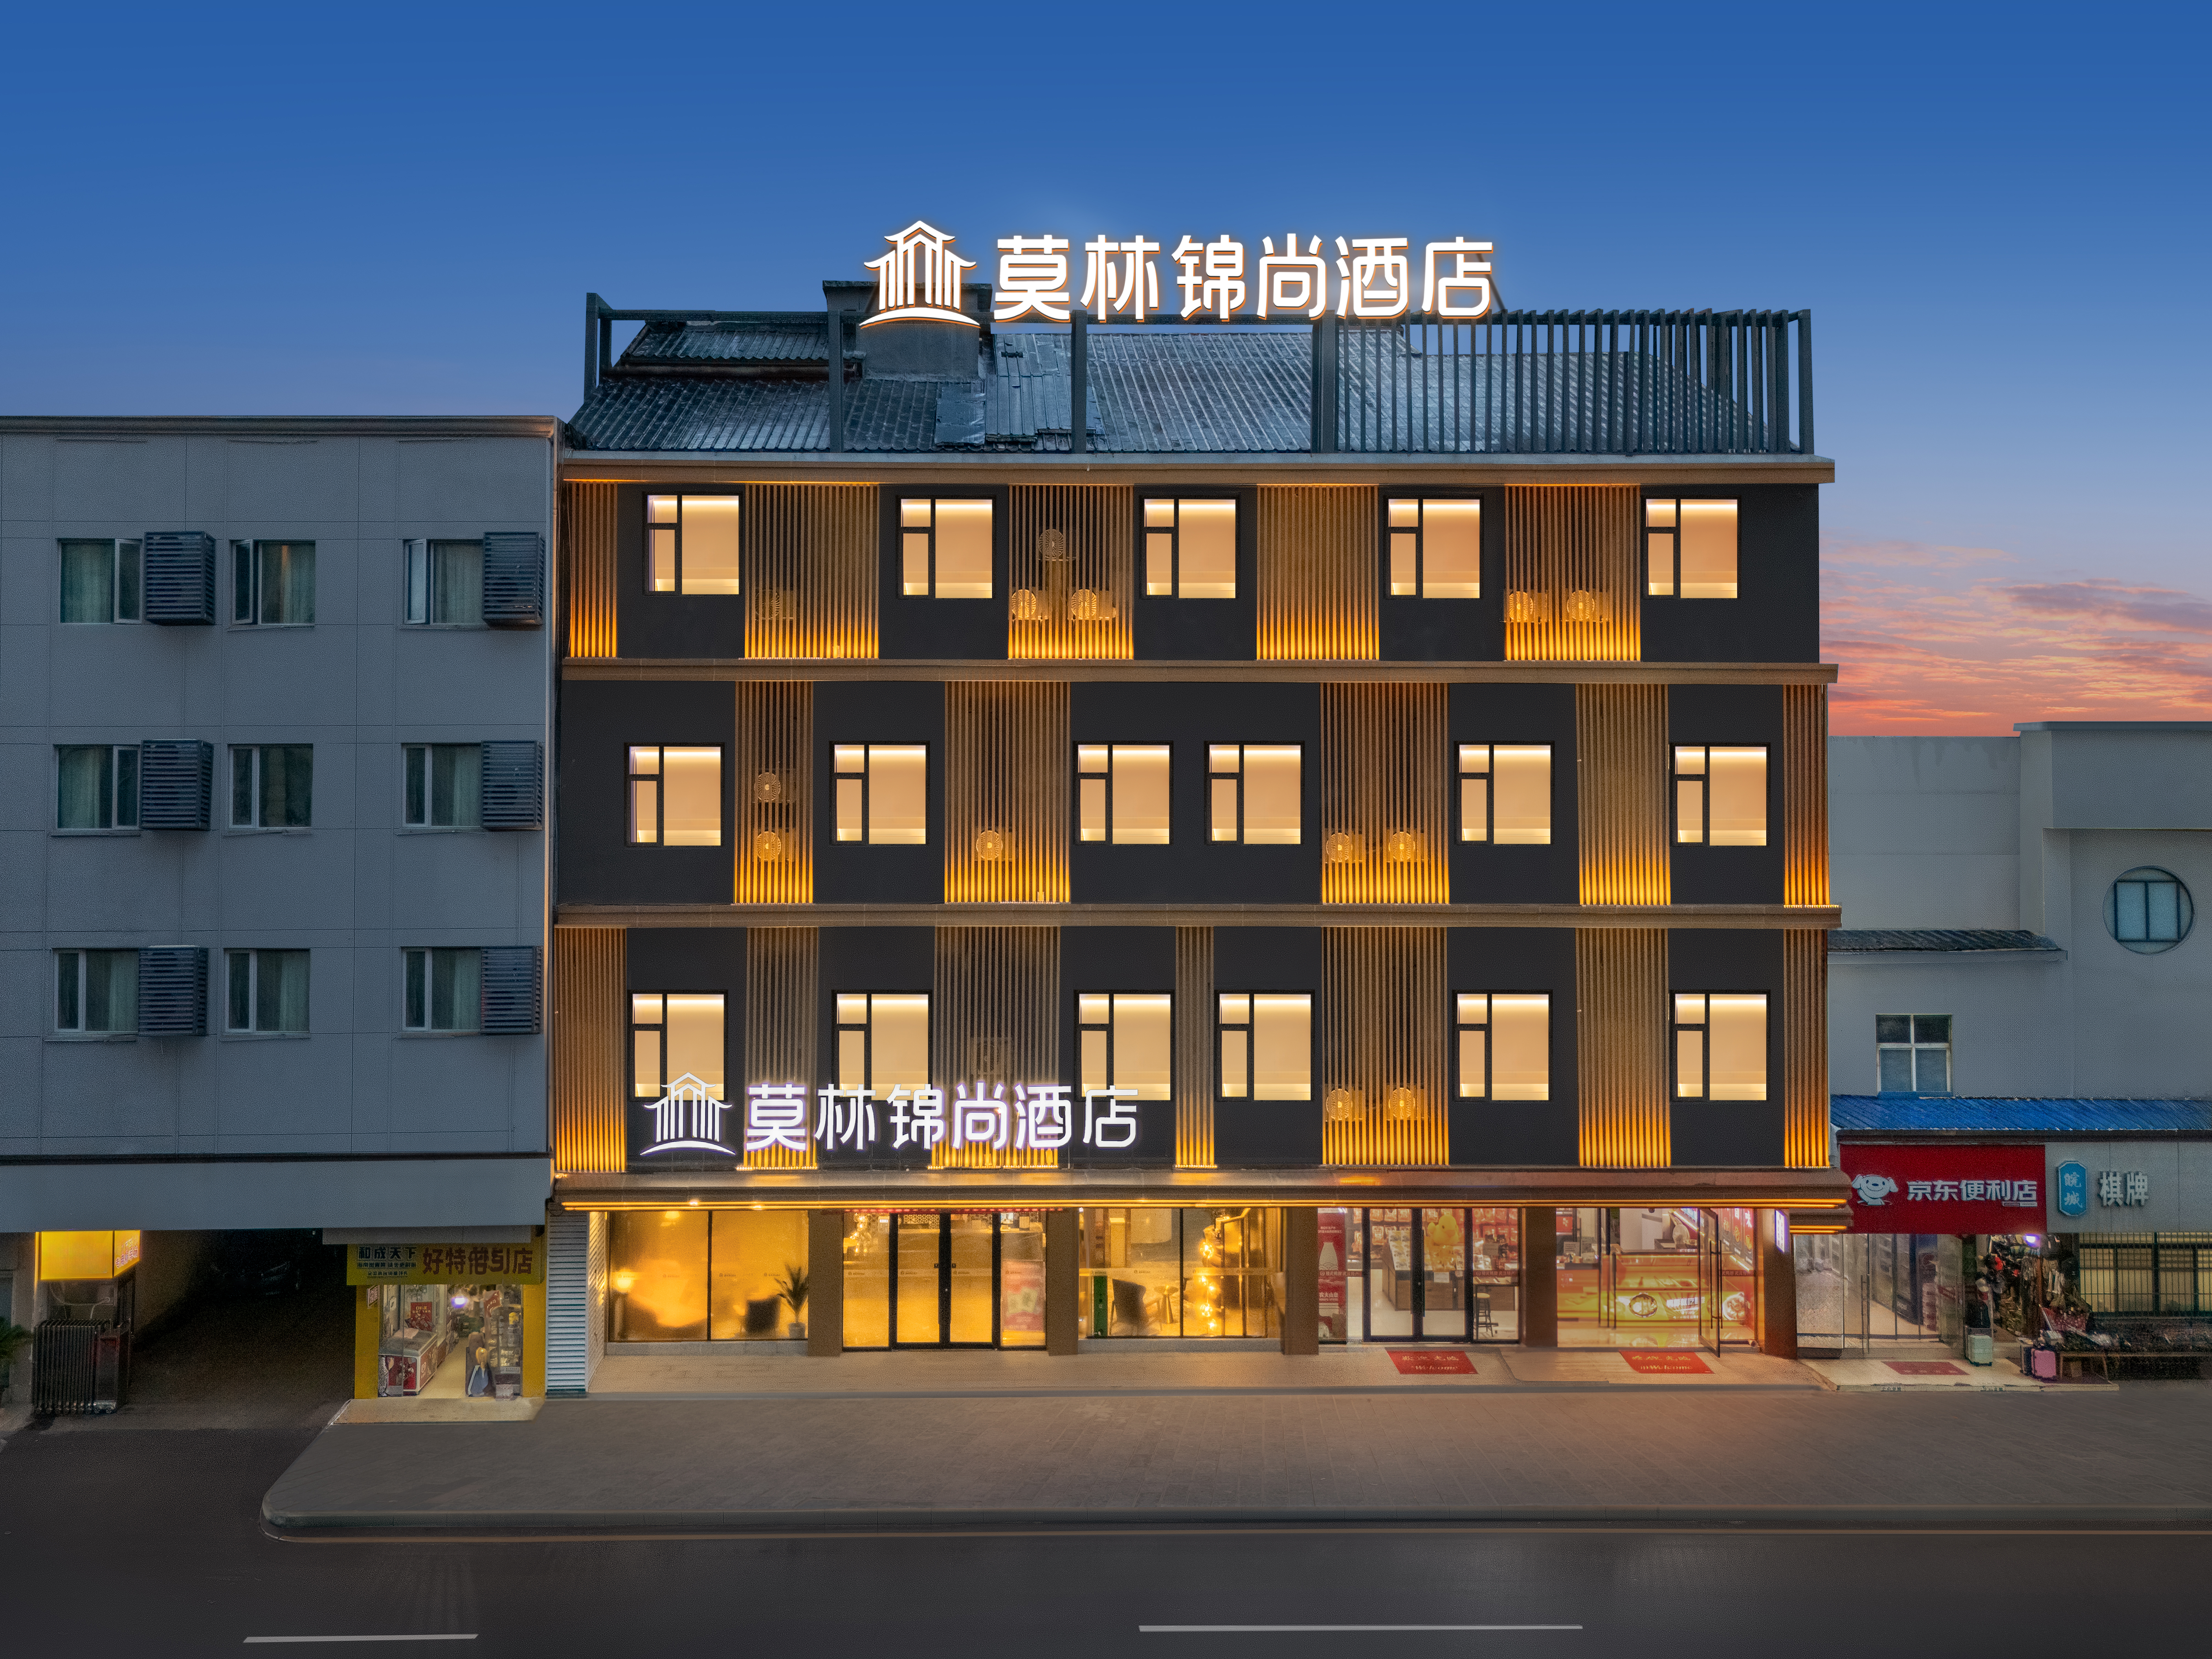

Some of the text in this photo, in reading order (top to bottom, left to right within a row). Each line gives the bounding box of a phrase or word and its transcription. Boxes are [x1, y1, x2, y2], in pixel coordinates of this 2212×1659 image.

[993, 233, 1493, 322] 莫林锦尚酒店
[746, 1082, 1139, 1150] 莫林锦尚酒店
[1907, 1179, 2037, 1201] 京东便利店
[2099, 1172, 2149, 1207] 棋牌
[359, 1246, 417, 1259] 和成天下
